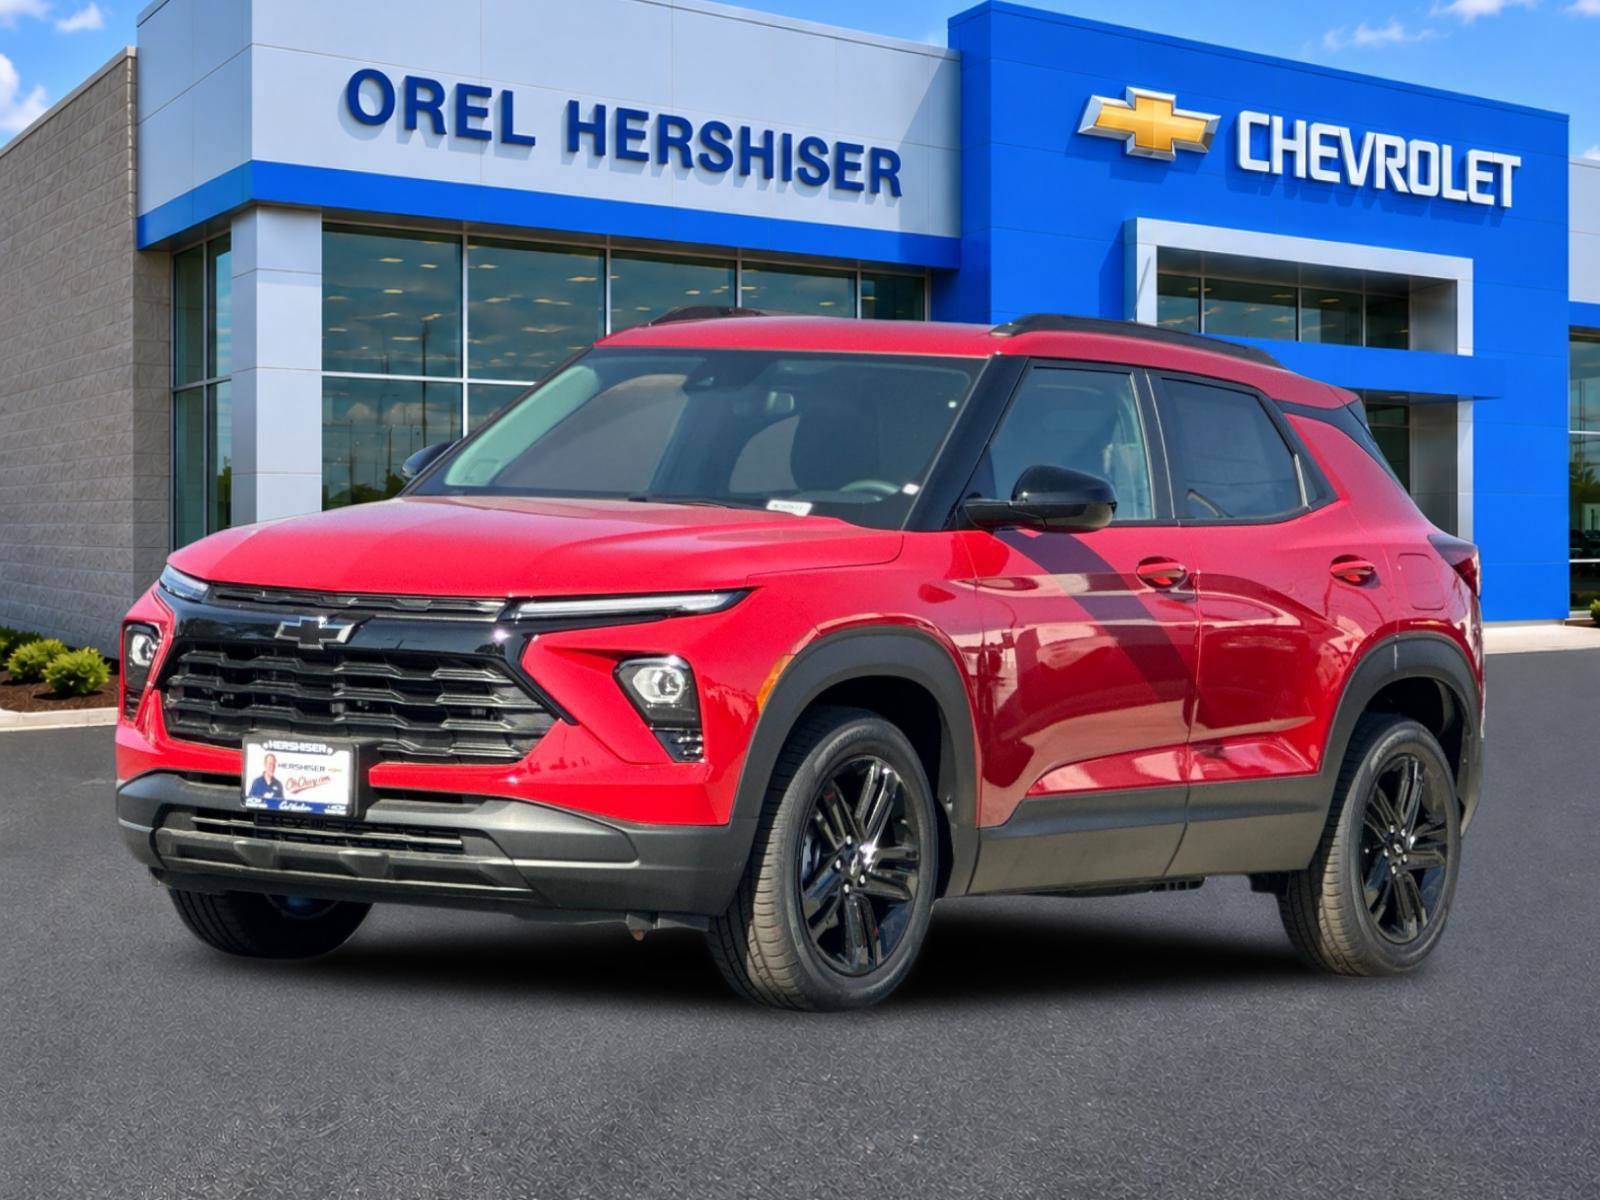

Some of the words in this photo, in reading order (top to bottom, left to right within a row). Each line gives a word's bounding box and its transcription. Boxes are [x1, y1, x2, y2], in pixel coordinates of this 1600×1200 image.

[346, 68, 535, 146] OREL
[567, 100, 902, 197] HERSHISER
[1237, 110, 1521, 207] CHEVROLET
[269, 740, 327, 753] HERSHISER
[278, 763, 326, 772] HERSHISER
